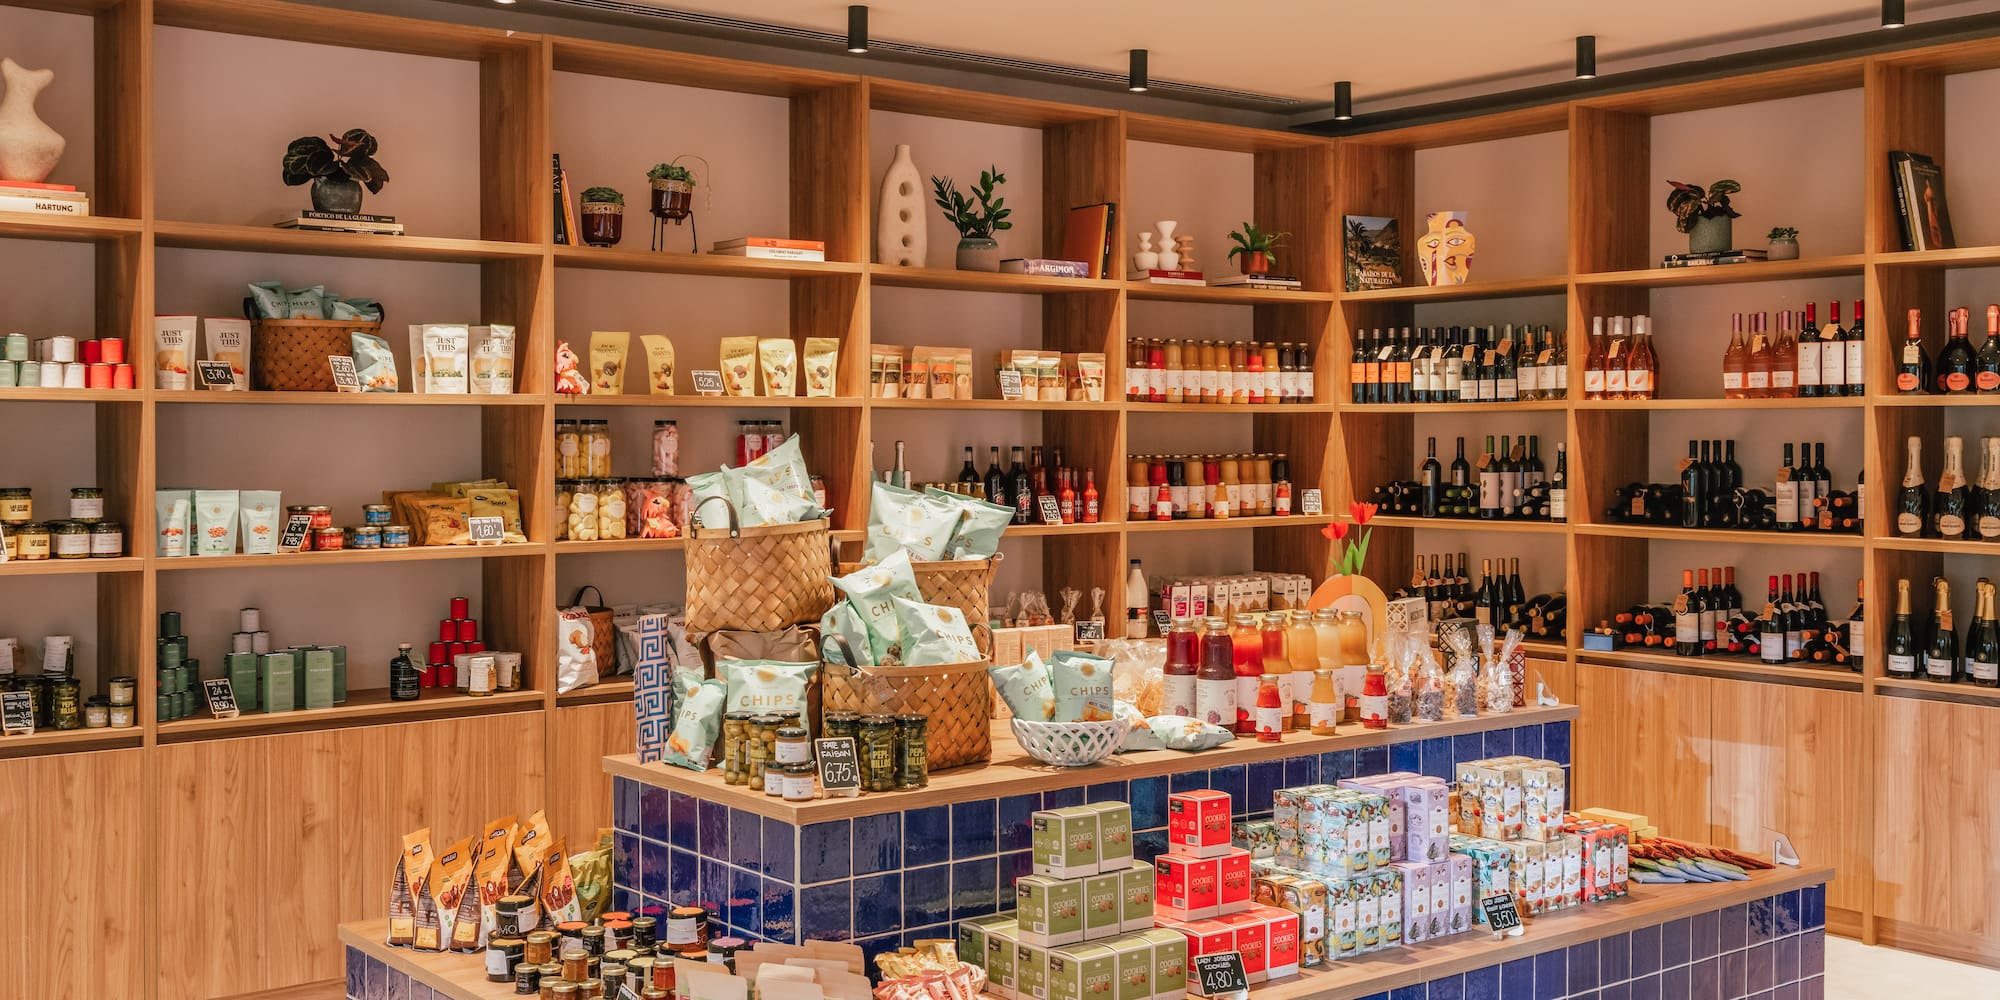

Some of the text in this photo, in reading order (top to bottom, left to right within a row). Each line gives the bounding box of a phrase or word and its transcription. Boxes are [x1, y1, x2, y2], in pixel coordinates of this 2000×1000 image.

[552, 158, 561, 194] CLAVE
[35, 202, 74, 213] HARTUNG
[1039, 264, 1075, 274] ARGIMON
[162, 336, 184, 344] THIS
[221, 338, 241, 346] THIS
[206, 369, 226, 380] 3,70
[871, 591, 915, 618] CHIS
[935, 629, 974, 646] CHIPS
[1023, 675, 1048, 696] CHIP
[1070, 686, 1109, 696] CHIPS
[740, 694, 794, 707] CHIPS
[680, 709, 697, 720] IPS
[1205, 813, 1227, 824] COOKIES
[1104, 825, 1128, 836] COOKIES
[1069, 831, 1093, 843] COOKIES
[1192, 875, 1214, 887] COOKIES
[1225, 871, 1247, 881] COOKIES
[1127, 885, 1150, 896] COOKIES
[1090, 892, 1115, 904] COOKIES
[1052, 898, 1078, 910] COOKIES
[1272, 933, 1295, 945] COOKIES
[1240, 940, 1263, 951] COOKIES
[1159, 957, 1183, 969] COOKIES
[1213, 954, 1237, 962] JOSEPH
[1123, 965, 1147, 977] COOKIES
[1204, 961, 1232, 970] COOKIES
[1086, 973, 1111, 986] COOKIES
[1206, 970, 1233, 990] 4,80
